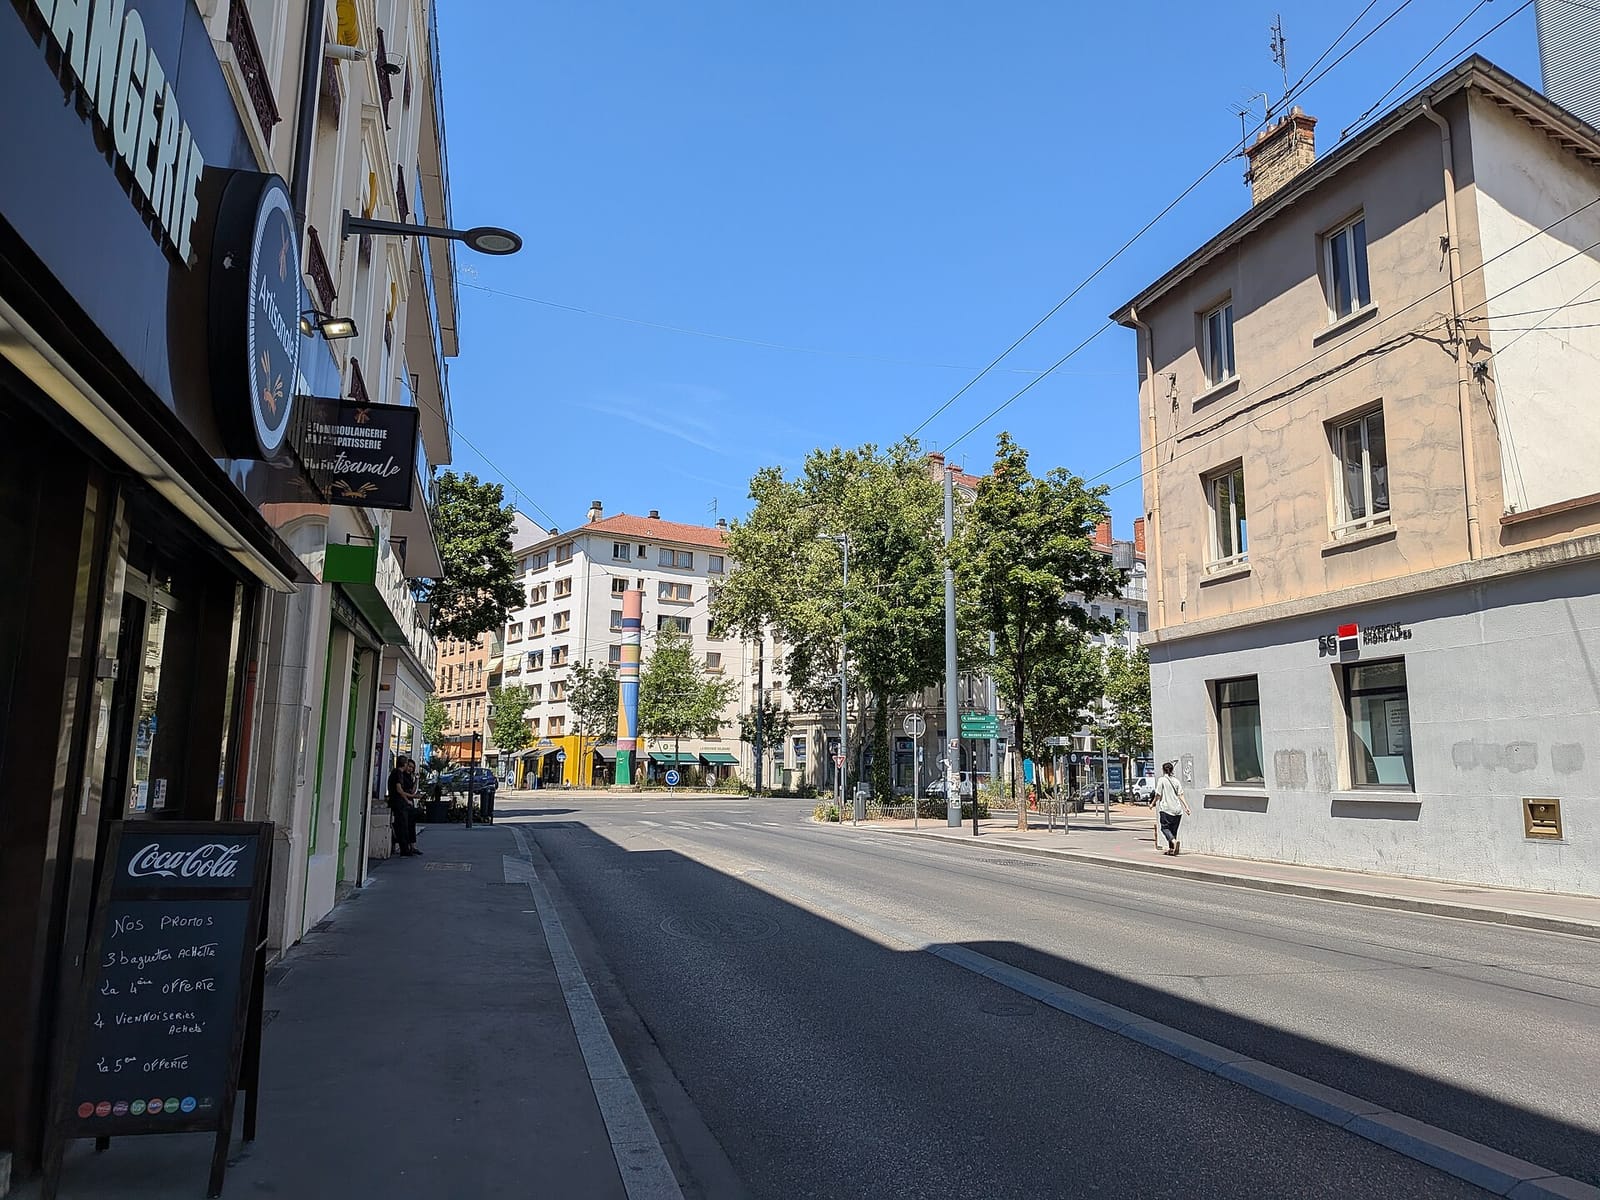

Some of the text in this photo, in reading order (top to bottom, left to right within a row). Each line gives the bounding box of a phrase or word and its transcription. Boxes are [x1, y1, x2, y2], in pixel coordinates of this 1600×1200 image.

[36, 0, 205, 264] ANGERIE
[259, 274, 294, 363] Artisanale
[336, 425, 388, 439] OULANGERIE
[332, 451, 400, 477] tisanale
[127, 843, 247, 877] Coca-Cola
[102, 952, 116, 967] 3
